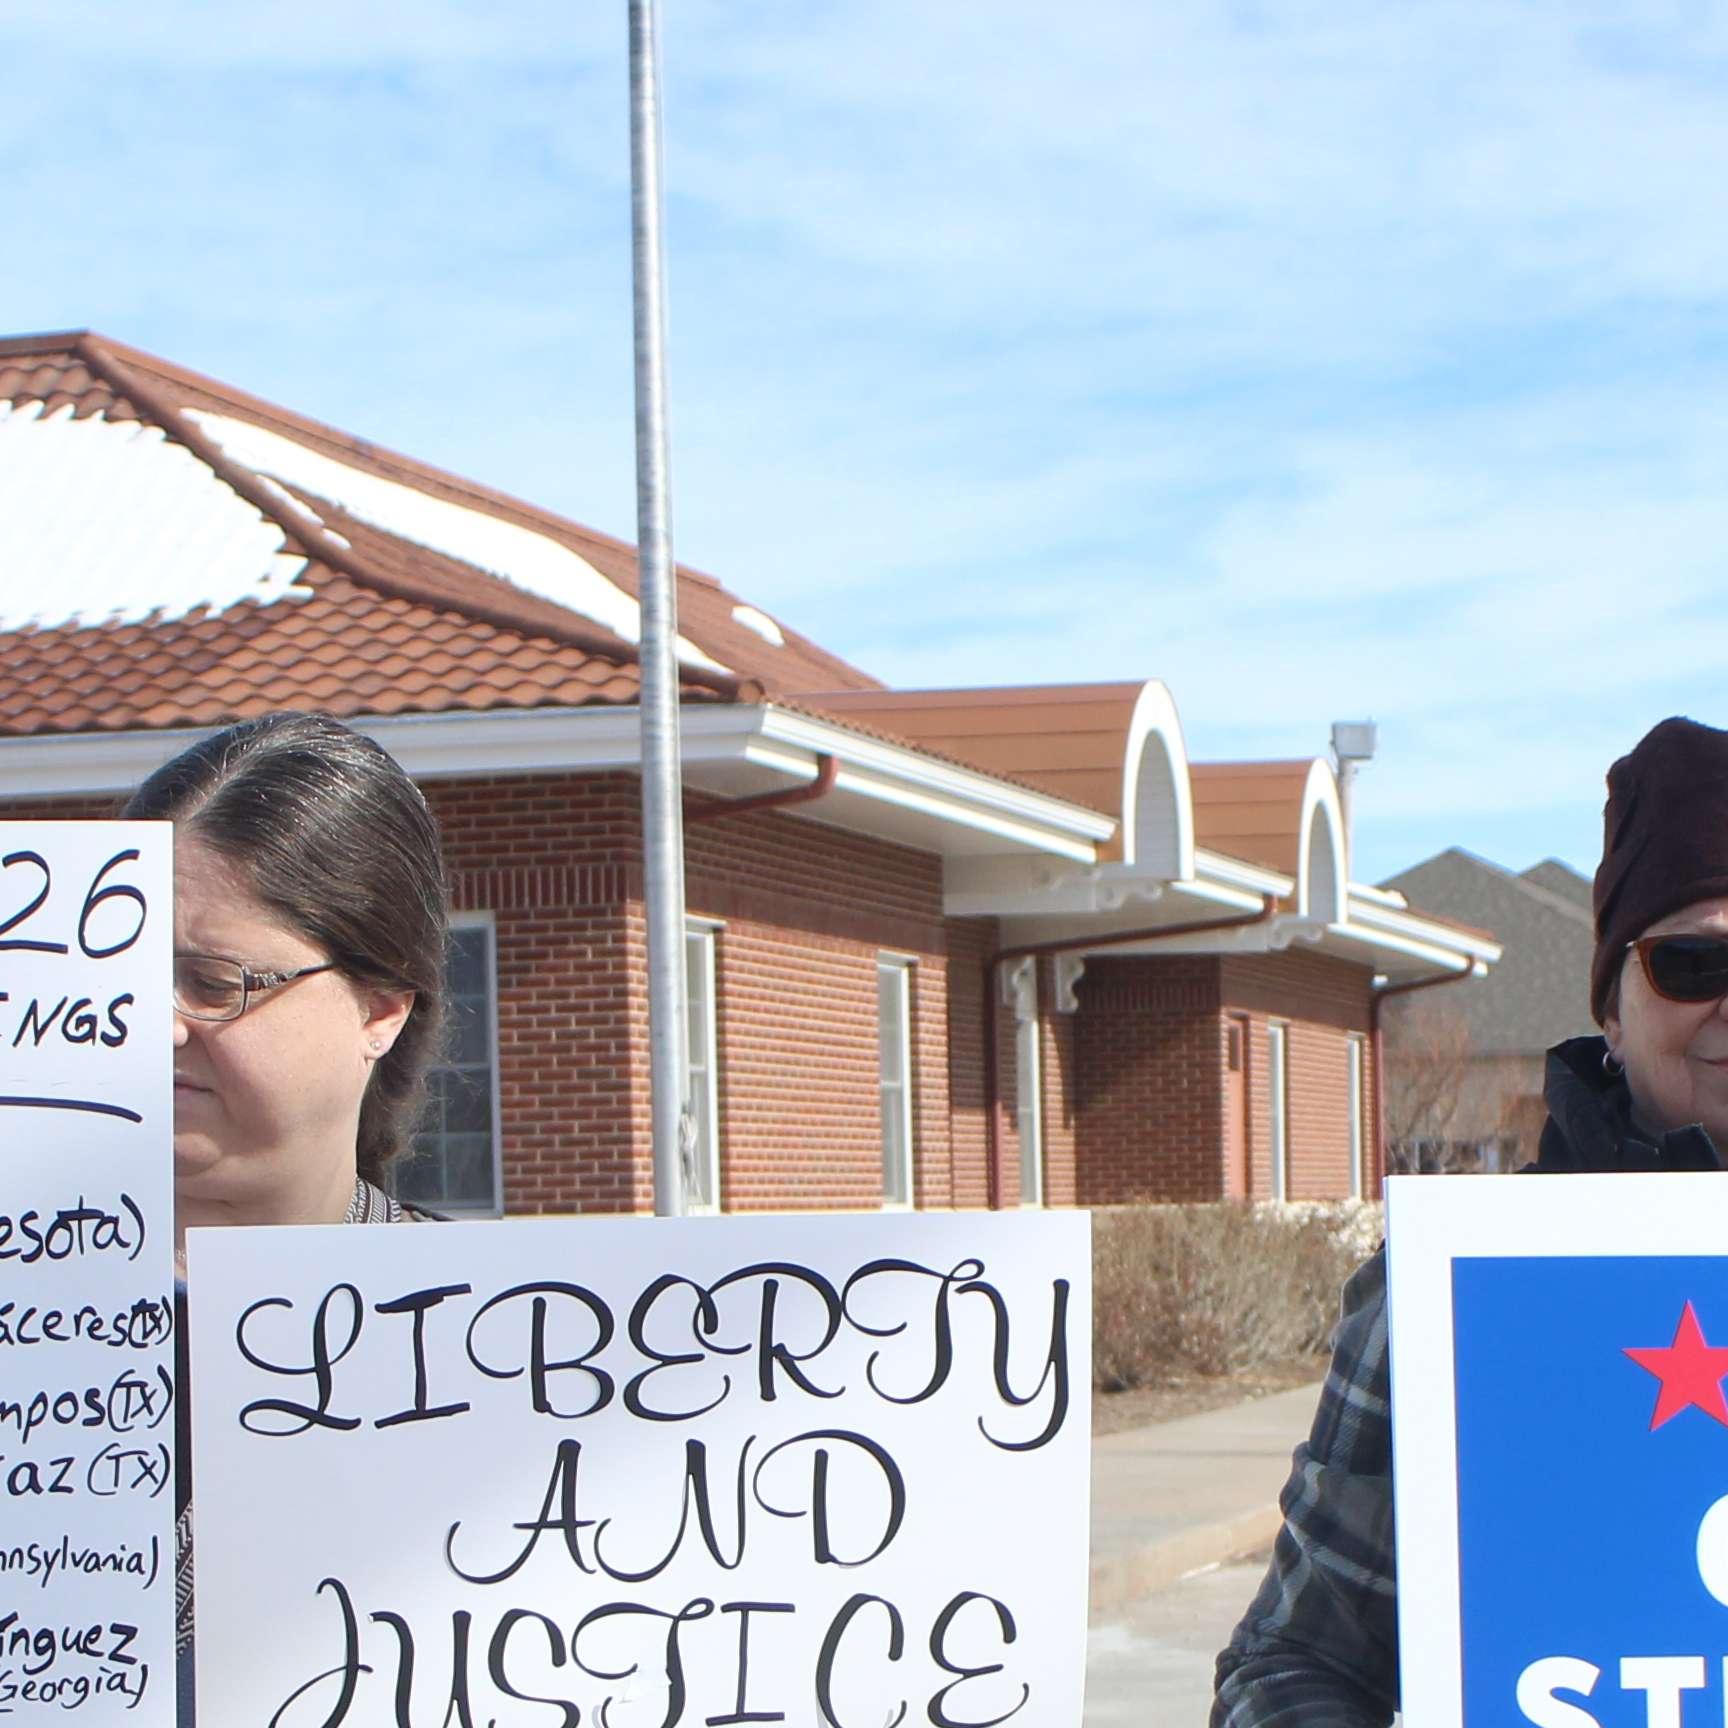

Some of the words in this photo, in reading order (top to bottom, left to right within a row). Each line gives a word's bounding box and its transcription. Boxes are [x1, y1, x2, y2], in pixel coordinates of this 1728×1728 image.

[236, 1259, 1069, 1452] LIBERTY
[87, 1443, 170, 1498] (TX)
[446, 1429, 906, 1585] AND
